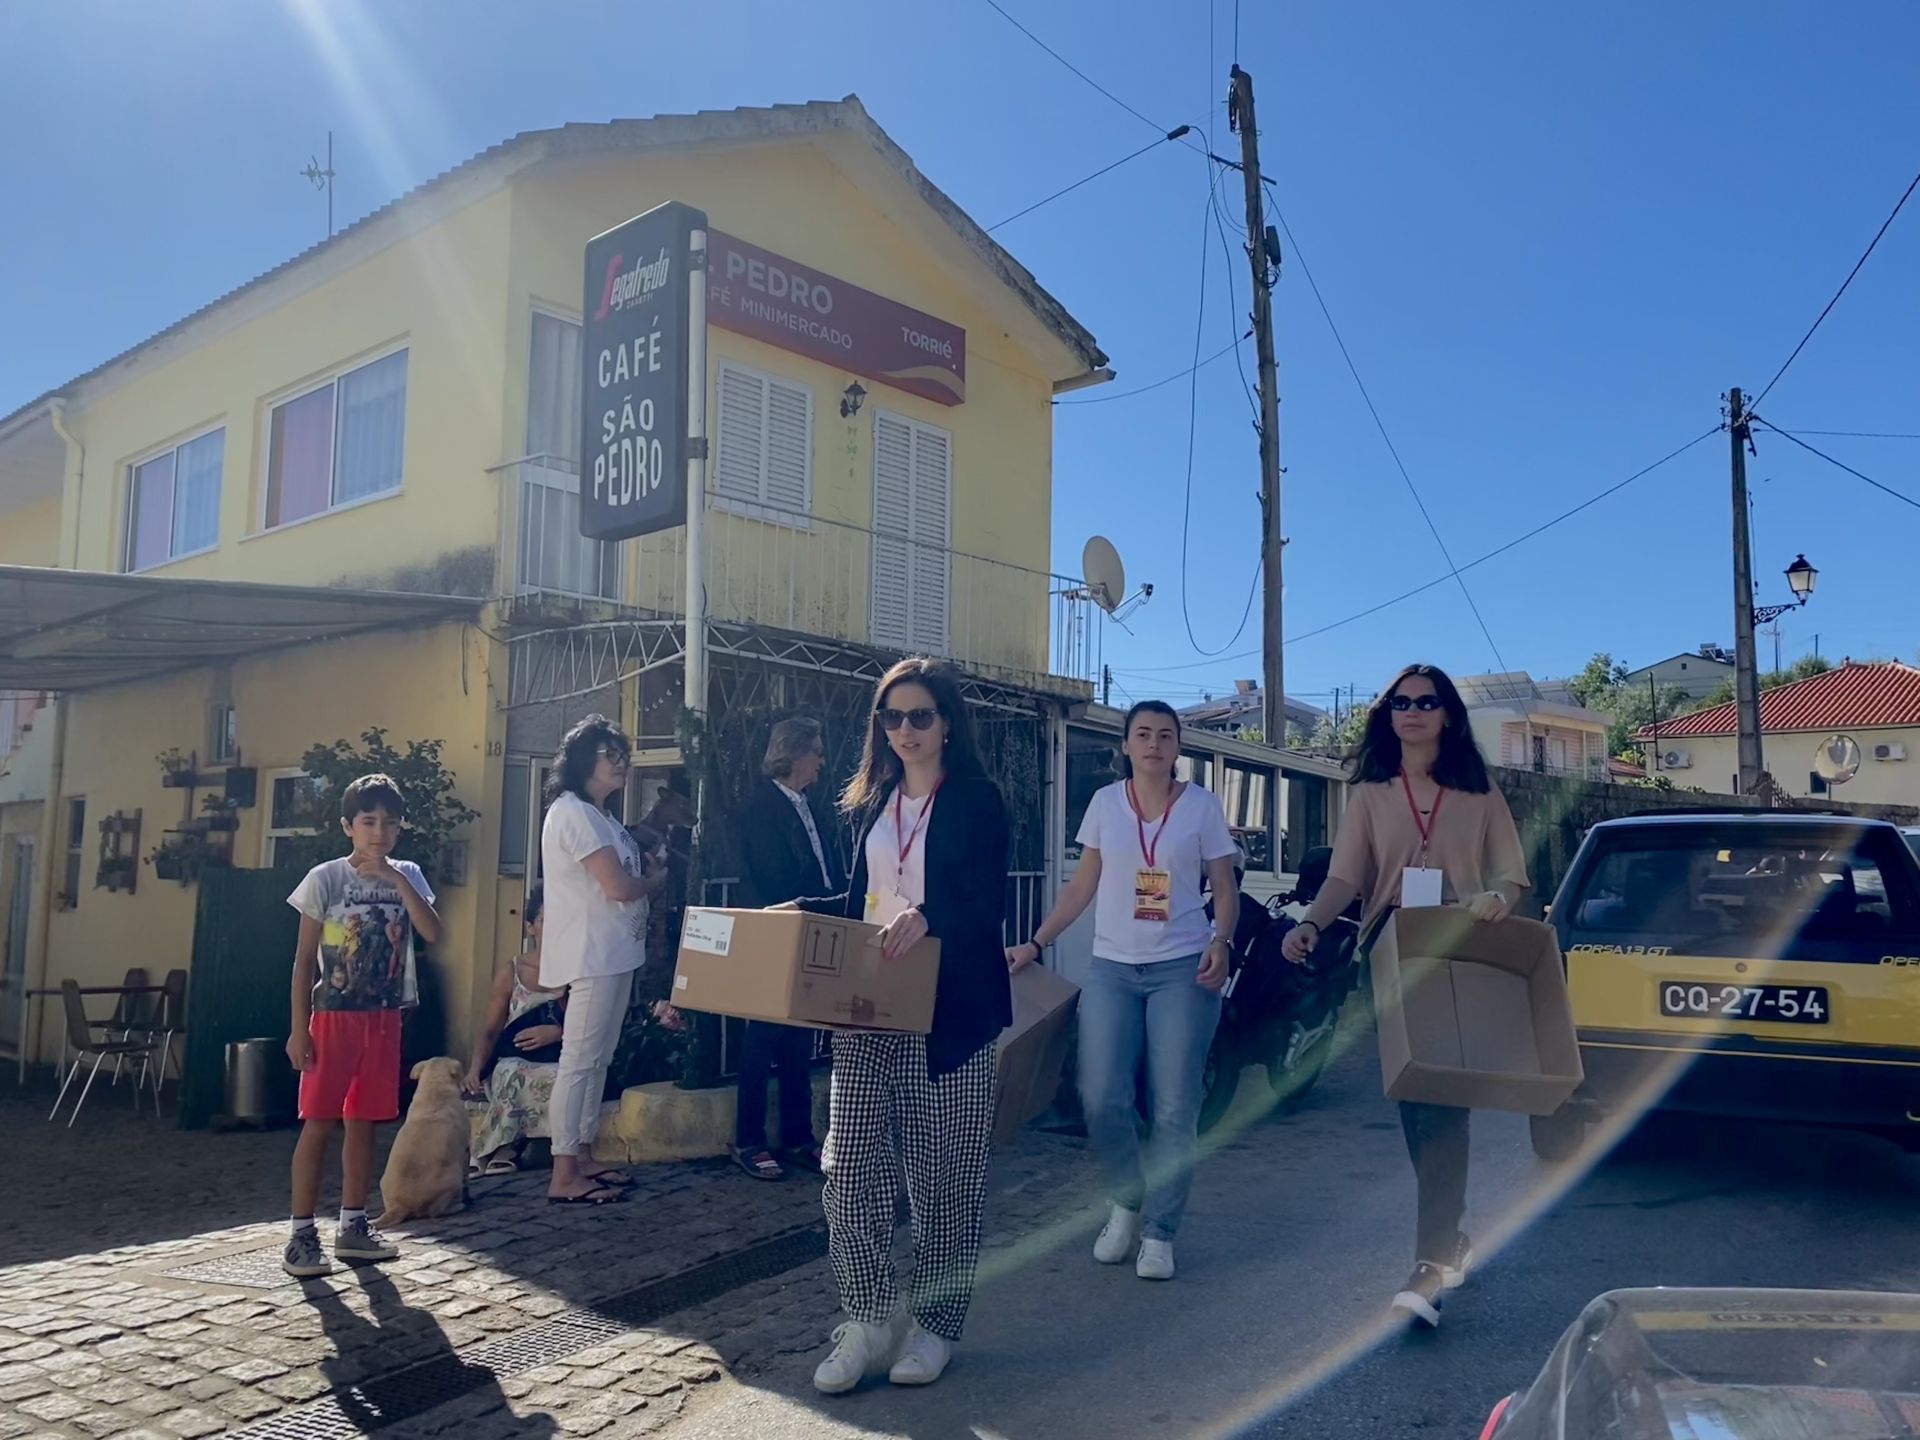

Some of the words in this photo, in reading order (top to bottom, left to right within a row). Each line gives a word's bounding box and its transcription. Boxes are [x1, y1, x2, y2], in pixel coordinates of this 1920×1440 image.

[595, 247, 670, 320] Segafredo
[726, 249, 833, 314] PEDRO
[706, 286, 731, 307] FÉ
[740, 296, 853, 349] MINIMERCADO
[598, 315, 662, 388] CAFÉ
[602, 394, 654, 444] SÃO
[593, 435, 662, 506] PEDRO
[487, 741, 501, 756] 18
[344, 883, 400, 906] FORTNIT
[1570, 943, 1624, 955] CORSA
[1646, 946, 1672, 957] GT
[1880, 955, 1920, 968] OPE
[1664, 985, 1825, 1019] CQ-27-54
